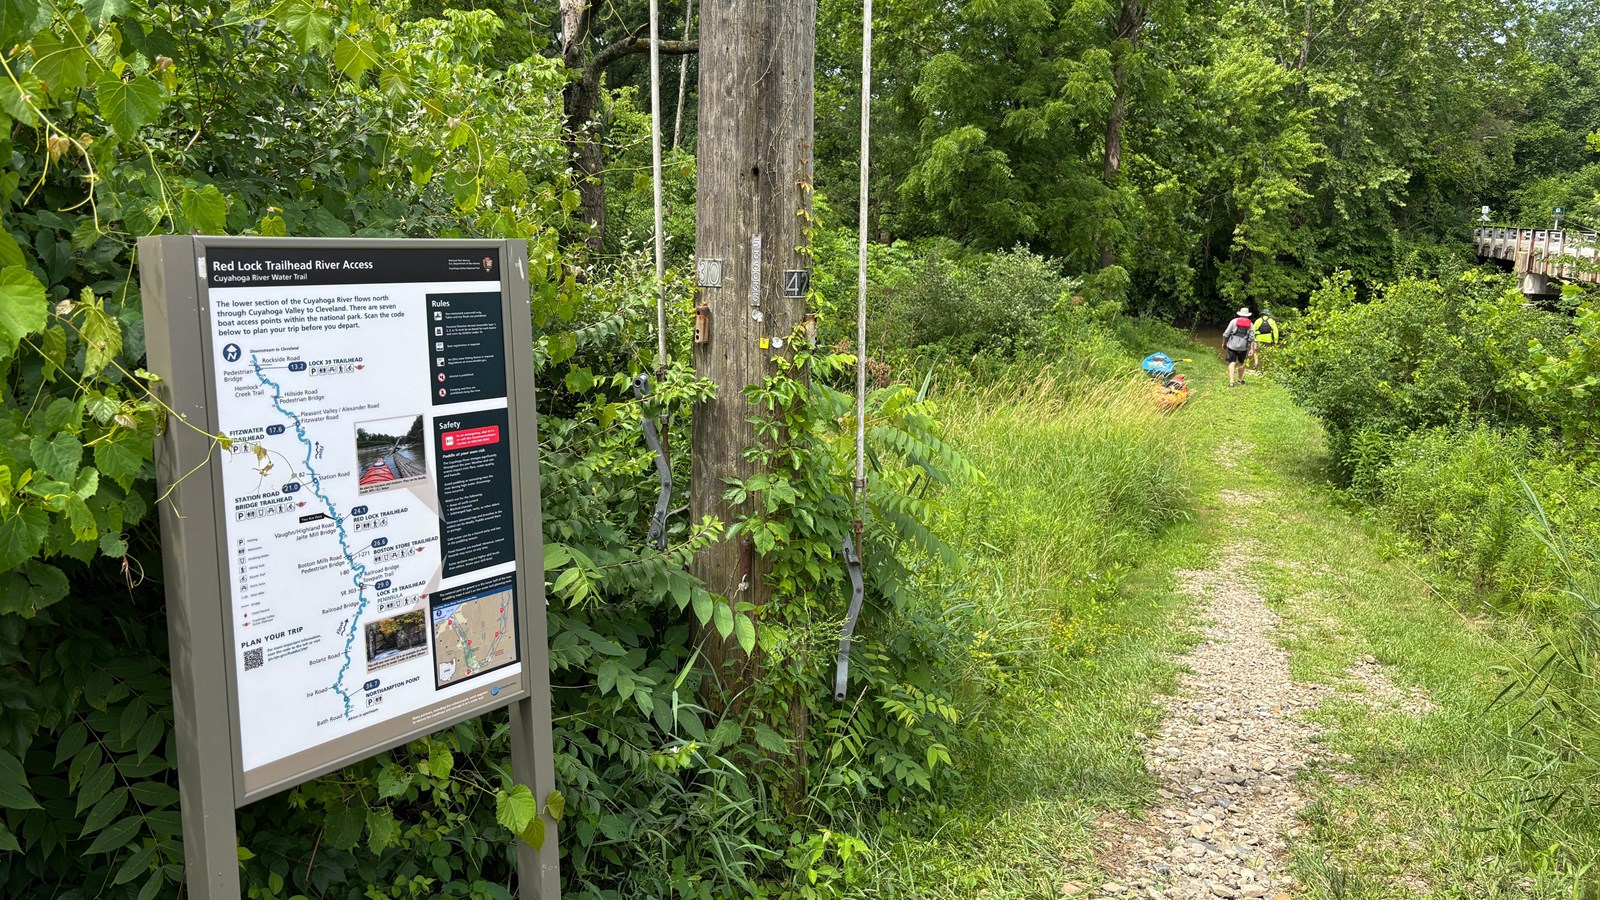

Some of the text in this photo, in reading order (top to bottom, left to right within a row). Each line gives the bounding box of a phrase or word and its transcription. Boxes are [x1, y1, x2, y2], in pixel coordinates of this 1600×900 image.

[213, 260, 373, 271] Red Lock Trailhead River Access
[700, 261, 720, 285] 30
[214, 274, 250, 283] Cuyahoga
[260, 318, 282, 326] points
[439, 421, 460, 430] Safety
[230, 428, 263, 436] FITZWATER
[235, 494, 260, 503] STATION
[236, 496, 292, 510] BRIDGE TRAILHEAD
[380, 508, 408, 517] TRAILHEAD
[274, 526, 320, 539] Vaughn/Highland
[320, 529, 336, 537] Bridge
[374, 546, 394, 554] BOSTON
[412, 536, 438, 546] TRAILHEAD
[298, 560, 315, 568] Boston
[301, 560, 345, 574] Pedestrian Bridge
[364, 564, 399, 576] Railroad Bridge
[364, 574, 383, 582] Towpath
[399, 580, 426, 590] TRAILHEAD
[378, 594, 403, 602] PENINSULA
[322, 602, 359, 614] Railroad Bridge
[241, 626, 304, 648] PLAN YOUR TRIP
[309, 657, 326, 666] Bolanz
[366, 676, 420, 698] NORTHAMPTON POINT
[317, 718, 328, 726] Bath
